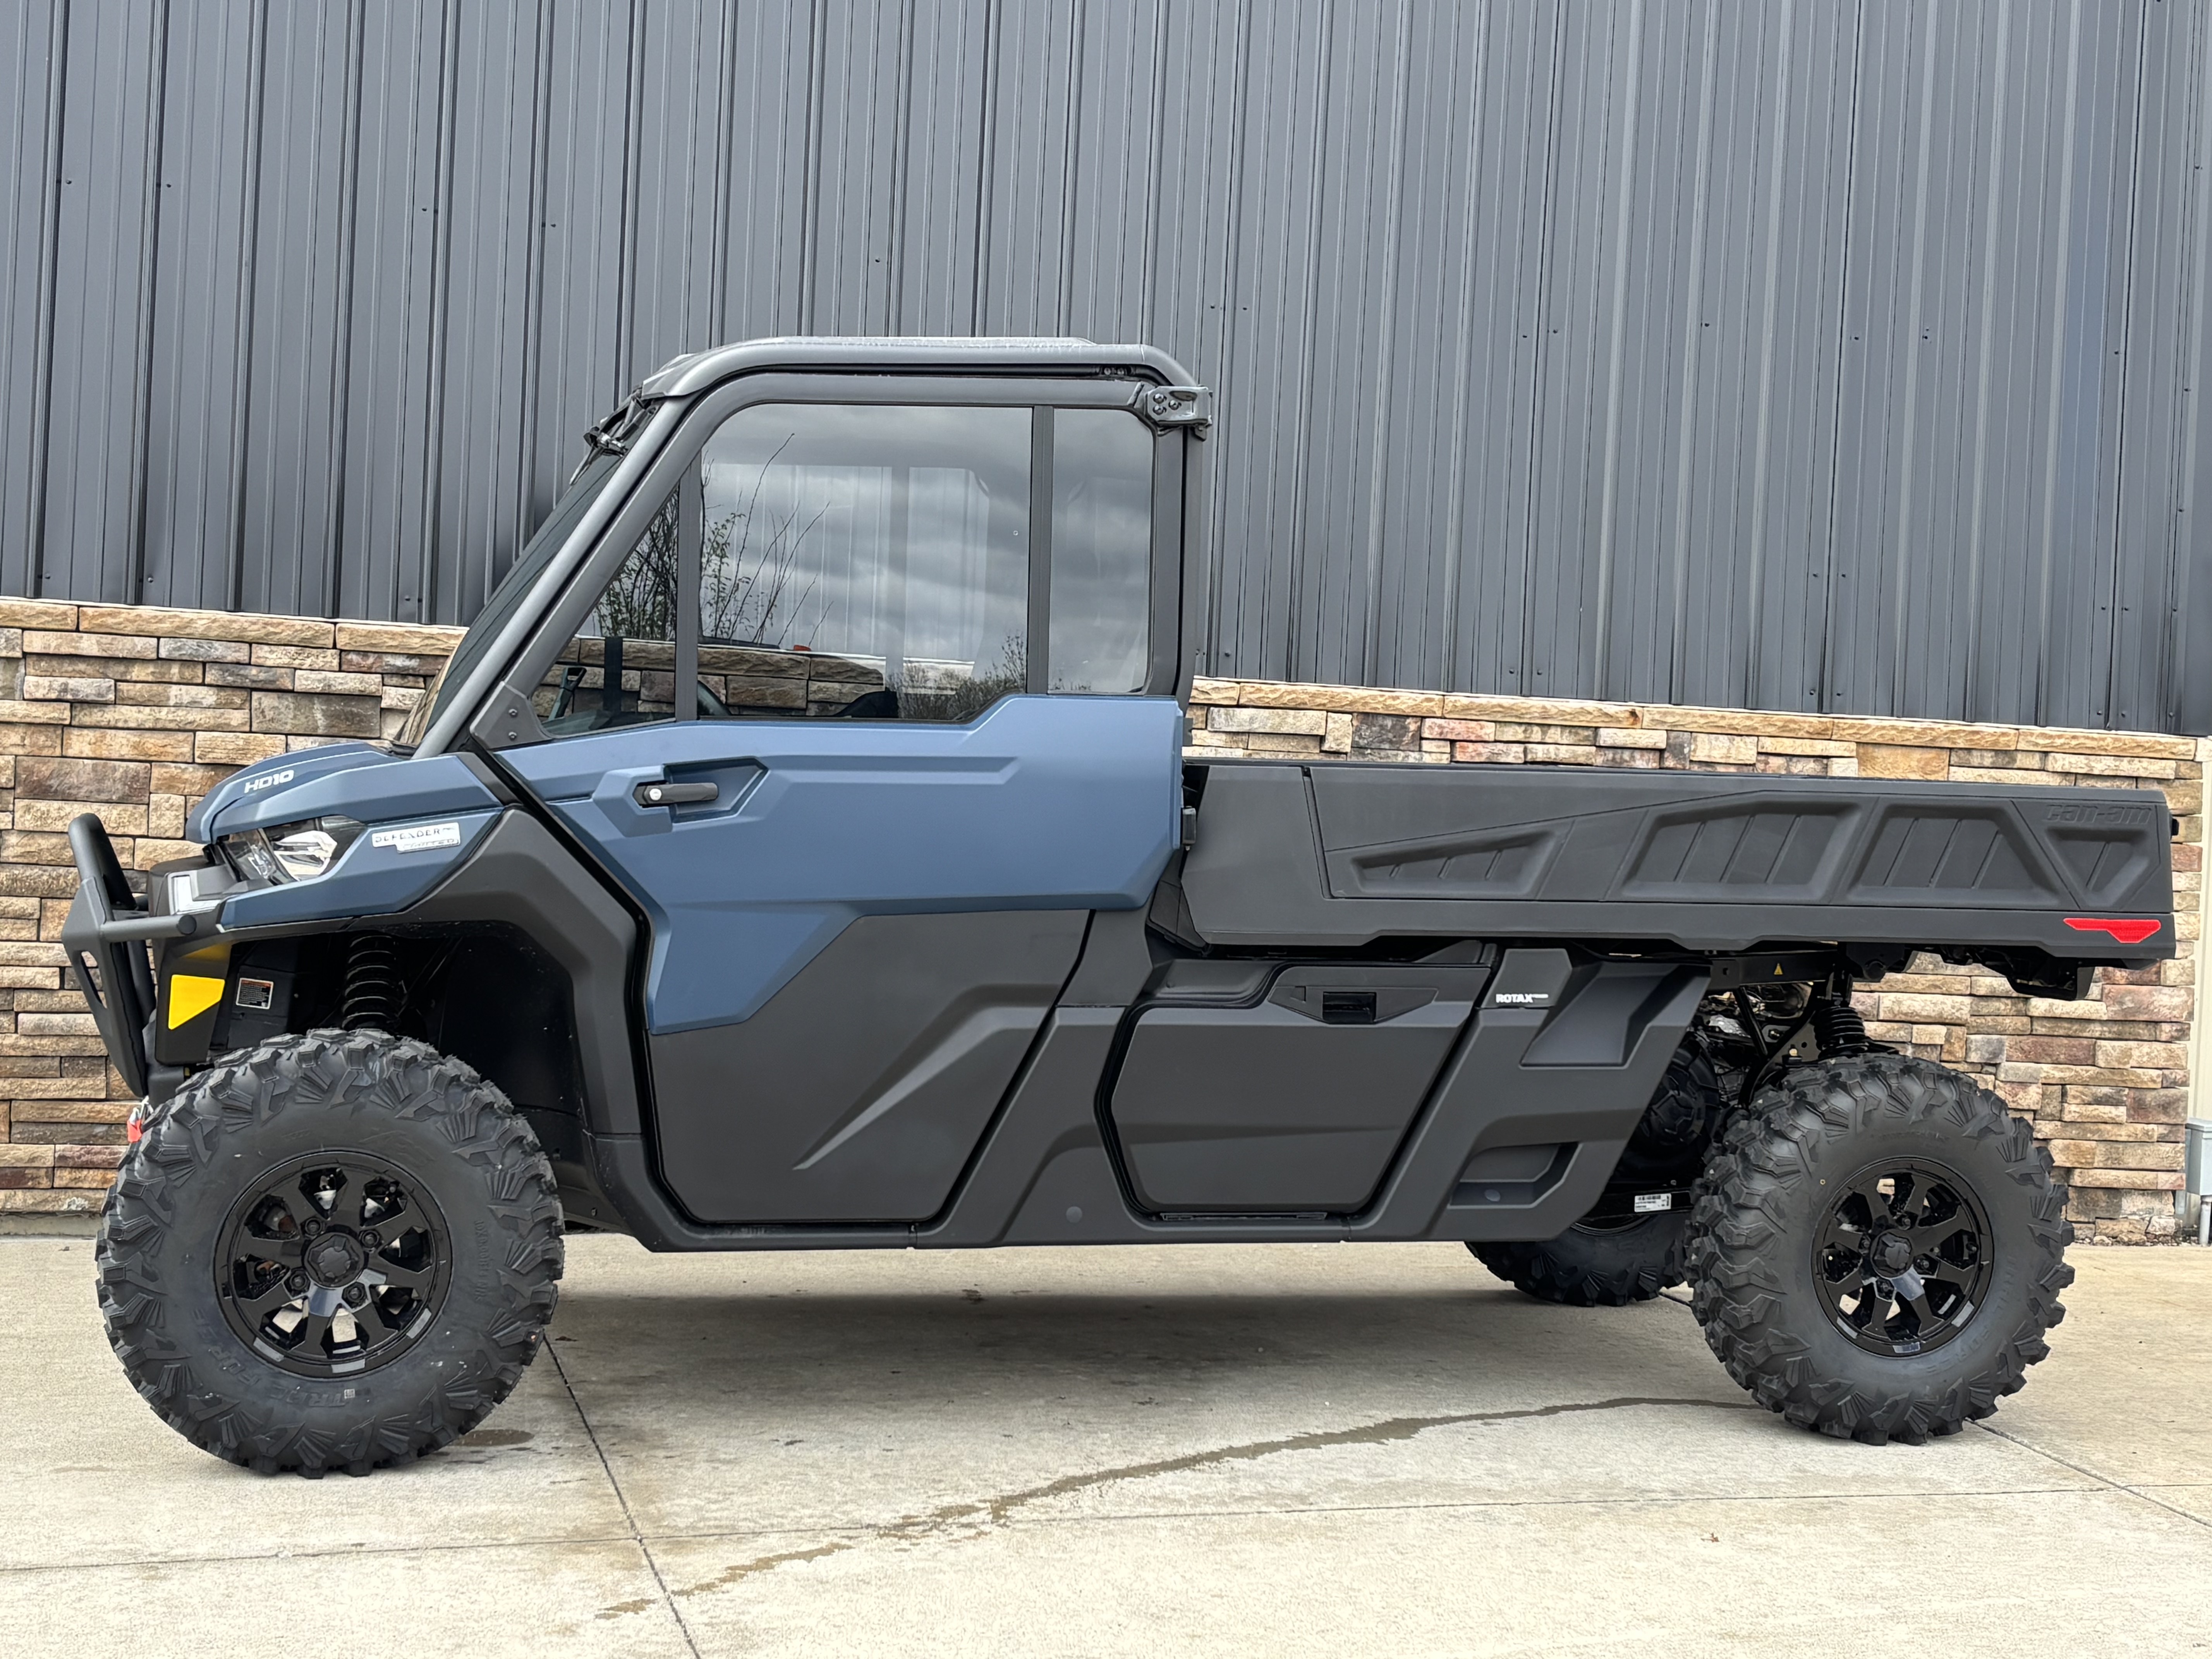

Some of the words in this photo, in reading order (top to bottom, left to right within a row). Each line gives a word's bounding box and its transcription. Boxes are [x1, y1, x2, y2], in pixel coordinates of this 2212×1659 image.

[244, 769, 294, 793] HD10
[375, 828, 440, 843] DEFENDER
[1496, 994, 1534, 1003] ROTAX
